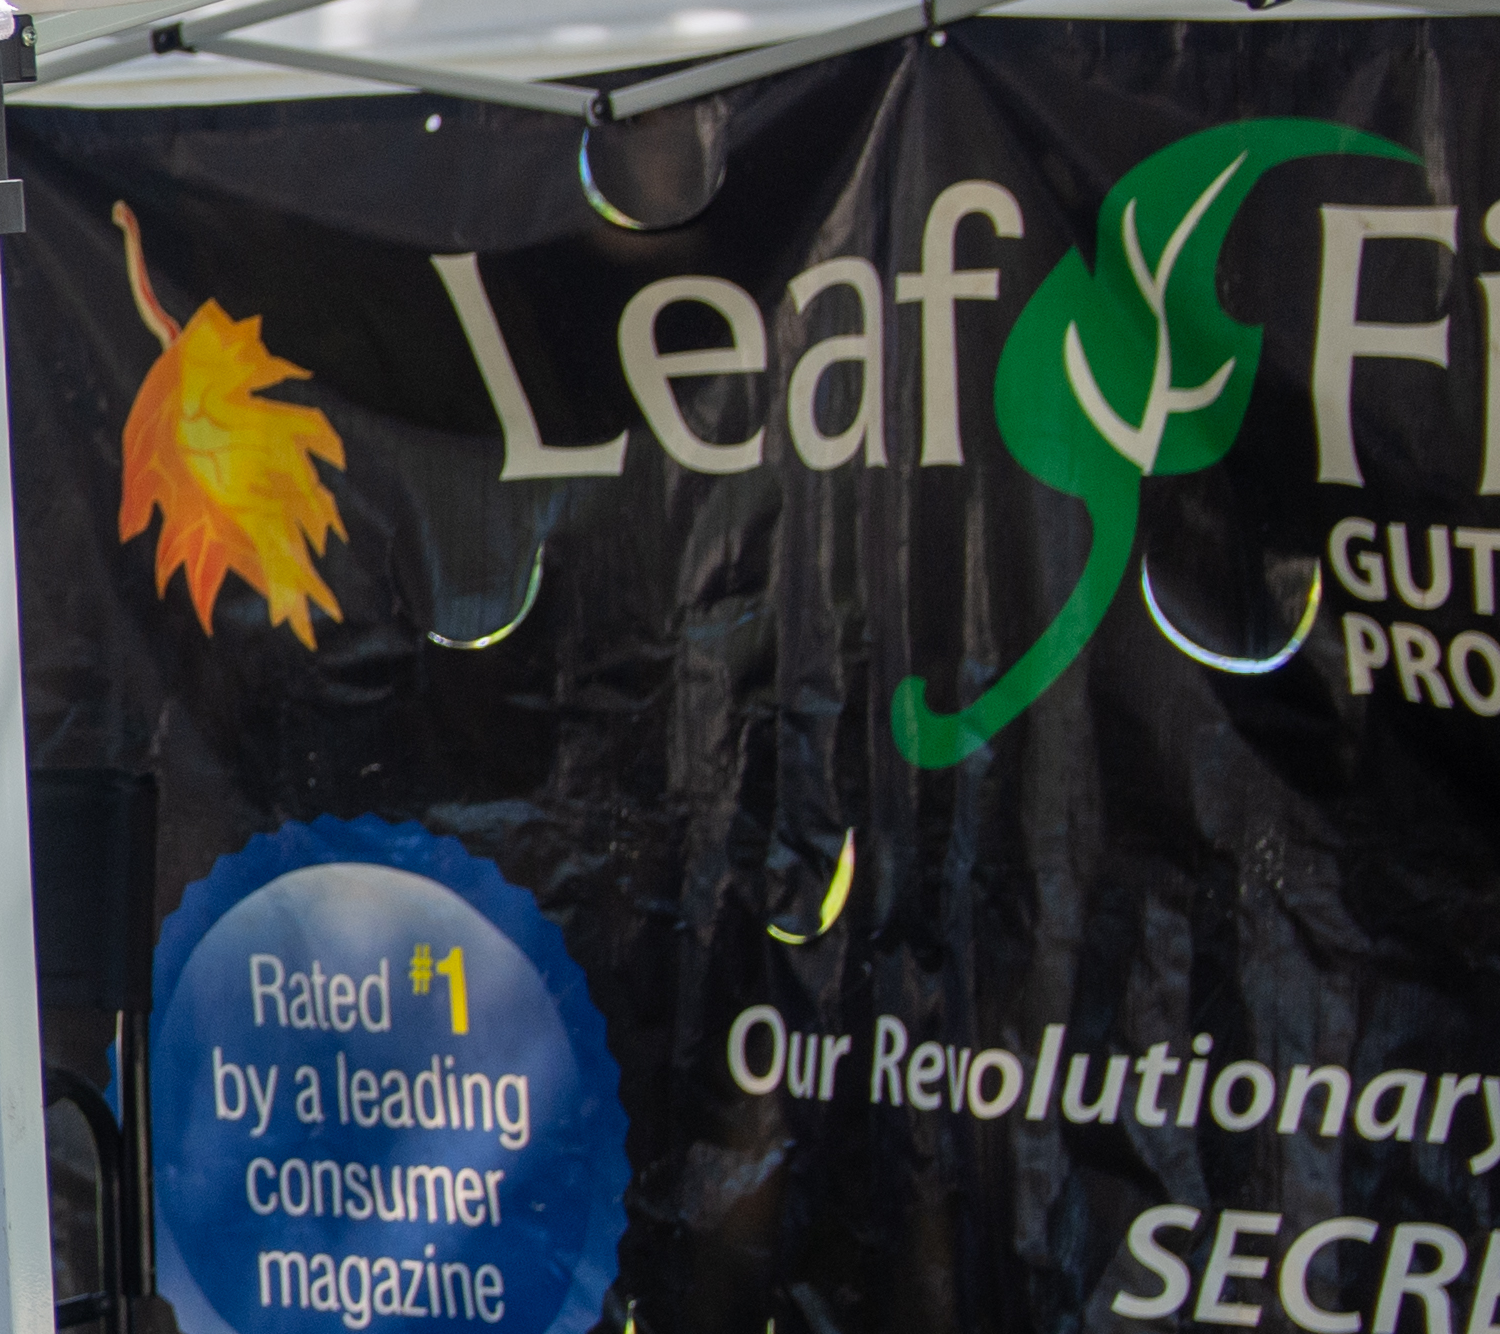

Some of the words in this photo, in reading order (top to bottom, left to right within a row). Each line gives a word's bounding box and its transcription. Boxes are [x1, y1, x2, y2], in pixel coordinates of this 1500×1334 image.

[429, 179, 1025, 482] Leaf
[249, 953, 391, 1033] Rated
[409, 944, 469, 1035] #1
[212, 1046, 278, 1138] by
[295, 1065, 324, 1124] a
[337, 1051, 531, 1151] leading
[727, 1004, 852, 1102] Our
[246, 1157, 505, 1227] consumer
[258, 1243, 506, 1330] magazine
